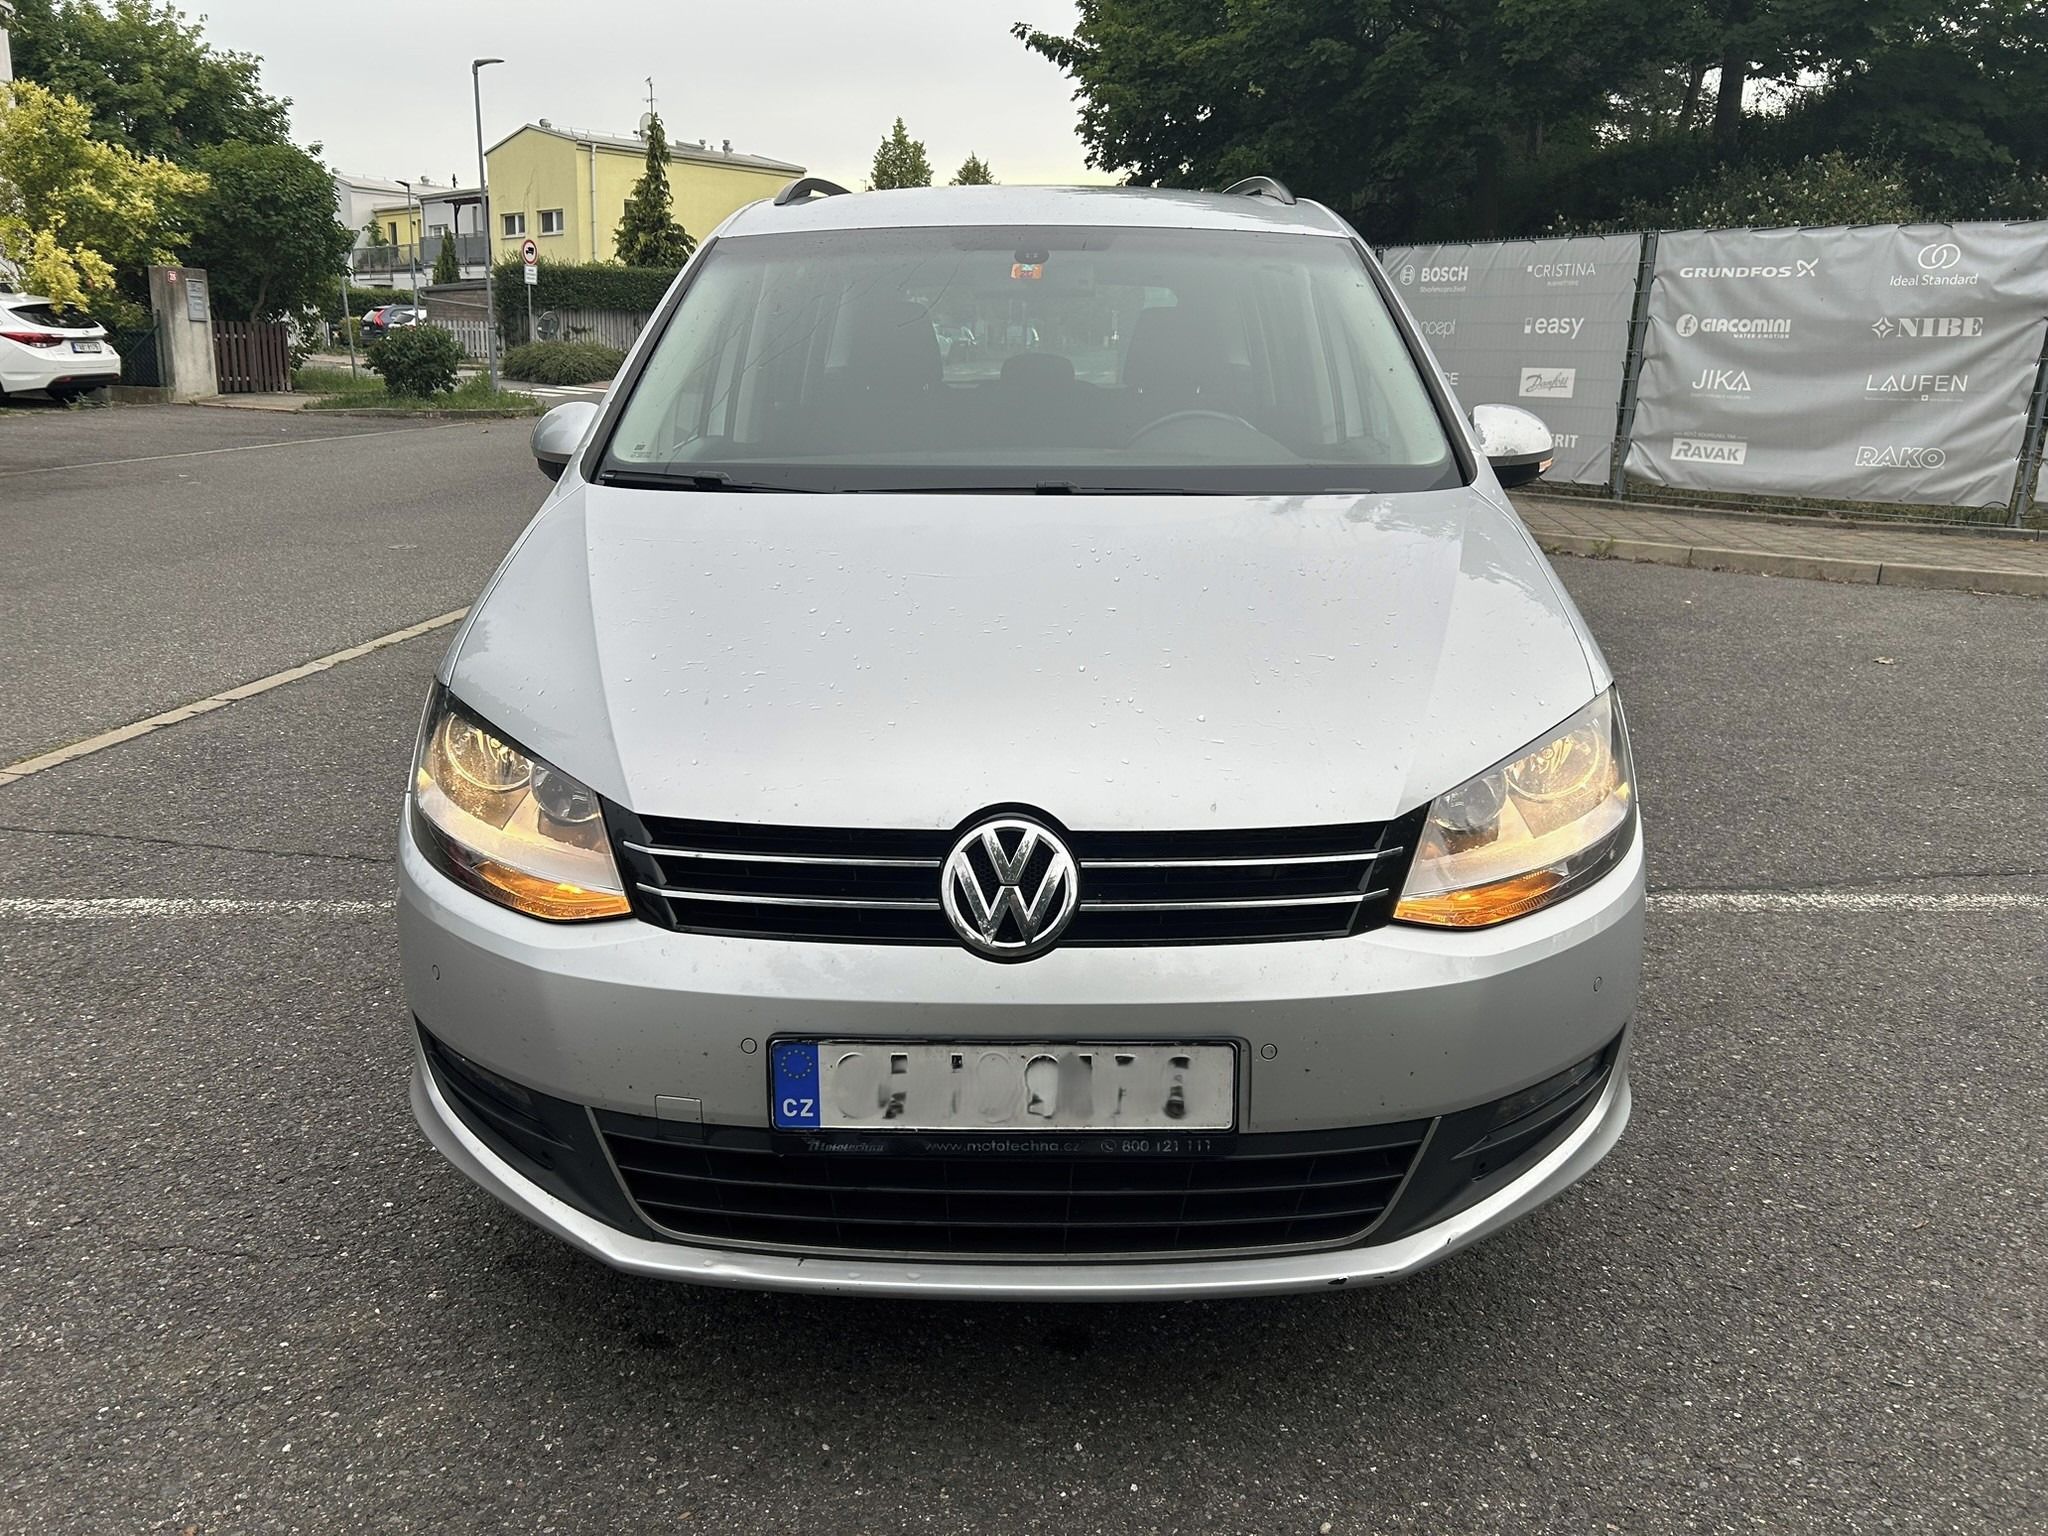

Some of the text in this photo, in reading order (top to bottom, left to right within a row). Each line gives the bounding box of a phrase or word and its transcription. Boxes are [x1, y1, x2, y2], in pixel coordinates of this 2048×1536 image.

[1421, 266, 1469, 282] BOSCH
[1534, 262, 1596, 278] CRISTINA
[1680, 266, 1793, 278] GRUNDFOS
[1889, 272, 1979, 287] Ideal Standard
[1420, 319, 1456, 339] ncept
[1535, 317, 1585, 339] easy
[1700, 318, 1791, 333] GIACOMINI
[1896, 317, 1984, 337] NIBE
[1692, 369, 1752, 392] JIKA
[1866, 374, 1969, 392] LAUFEN
[1675, 441, 1739, 462] RAVAK
[1855, 445, 1946, 469] RAKO
[782, 1098, 814, 1117] CZ
[1122, 1140, 1150, 1152] 800
[1156, 1140, 1179, 1152] 121
